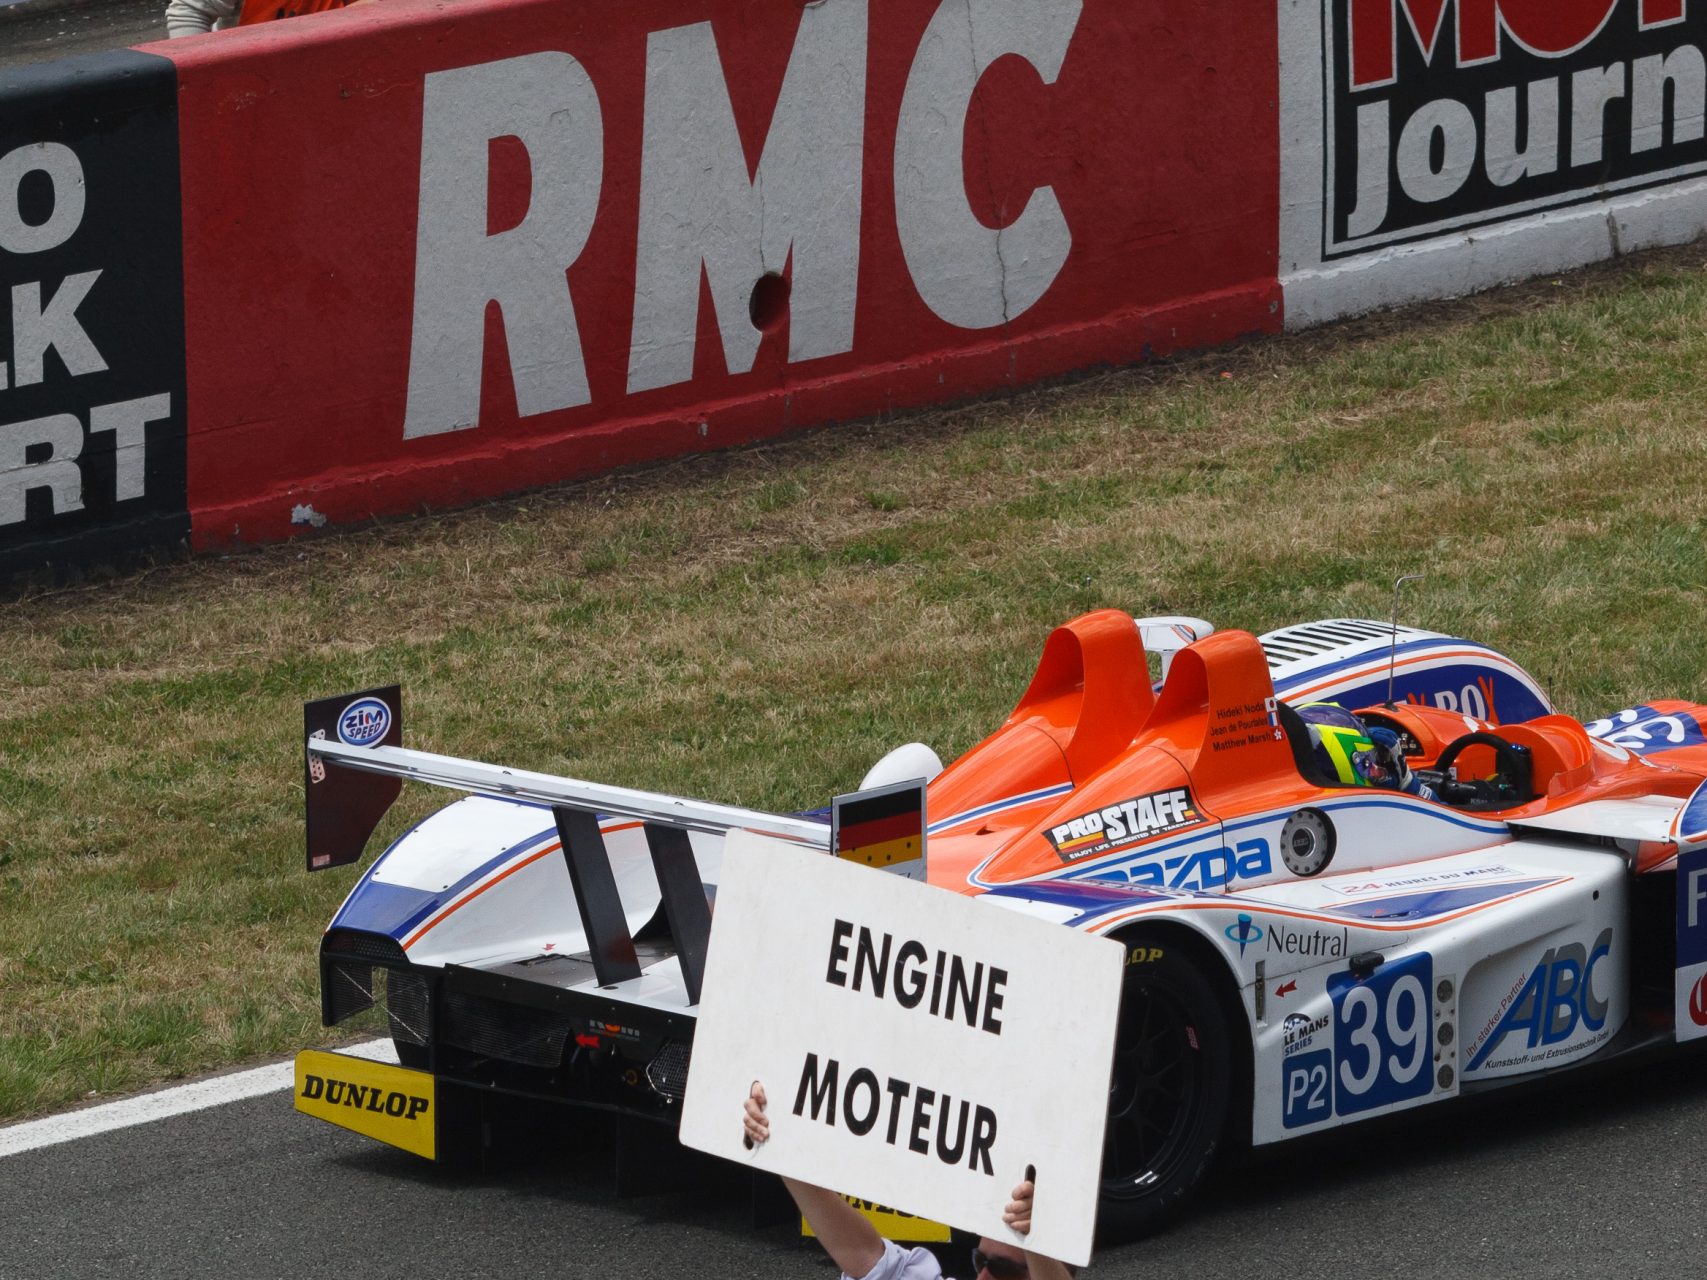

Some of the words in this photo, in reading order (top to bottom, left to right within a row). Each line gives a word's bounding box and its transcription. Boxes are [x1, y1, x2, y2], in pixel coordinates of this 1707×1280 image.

[402, 0, 1083, 441] RMC
[348, 722, 382, 740] SPEED
[1212, 738, 1247, 752] Matthew
[1247, 731, 1271, 744] Marsh
[1068, 847, 1093, 860] ENJOY
[1095, 843, 1110, 852] LIFE
[1112, 832, 1150, 847] PRESENTED
[1150, 829, 1161, 837] BY
[1084, 838, 1272, 894] azda
[1266, 923, 1348, 957] Neutral
[826, 918, 1008, 1036] ENGINE
[1464, 928, 1613, 1072] ABC
[1284, 1033, 1295, 1047] LE
[1298, 1015, 1330, 1040] MANS
[1340, 974, 1428, 1095] 39
[1466, 1041, 1478, 1058] Ihr
[1478, 1009, 1502, 1044] starker
[1500, 972, 1527, 1011] Partner
[1284, 1035, 1313, 1057] SERIES
[1530, 1051, 1546, 1063] und
[301, 1073, 430, 1120] DUNLOP
[1287, 1065, 1327, 1115] P2
[792, 1052, 997, 1177] MOTEUR
